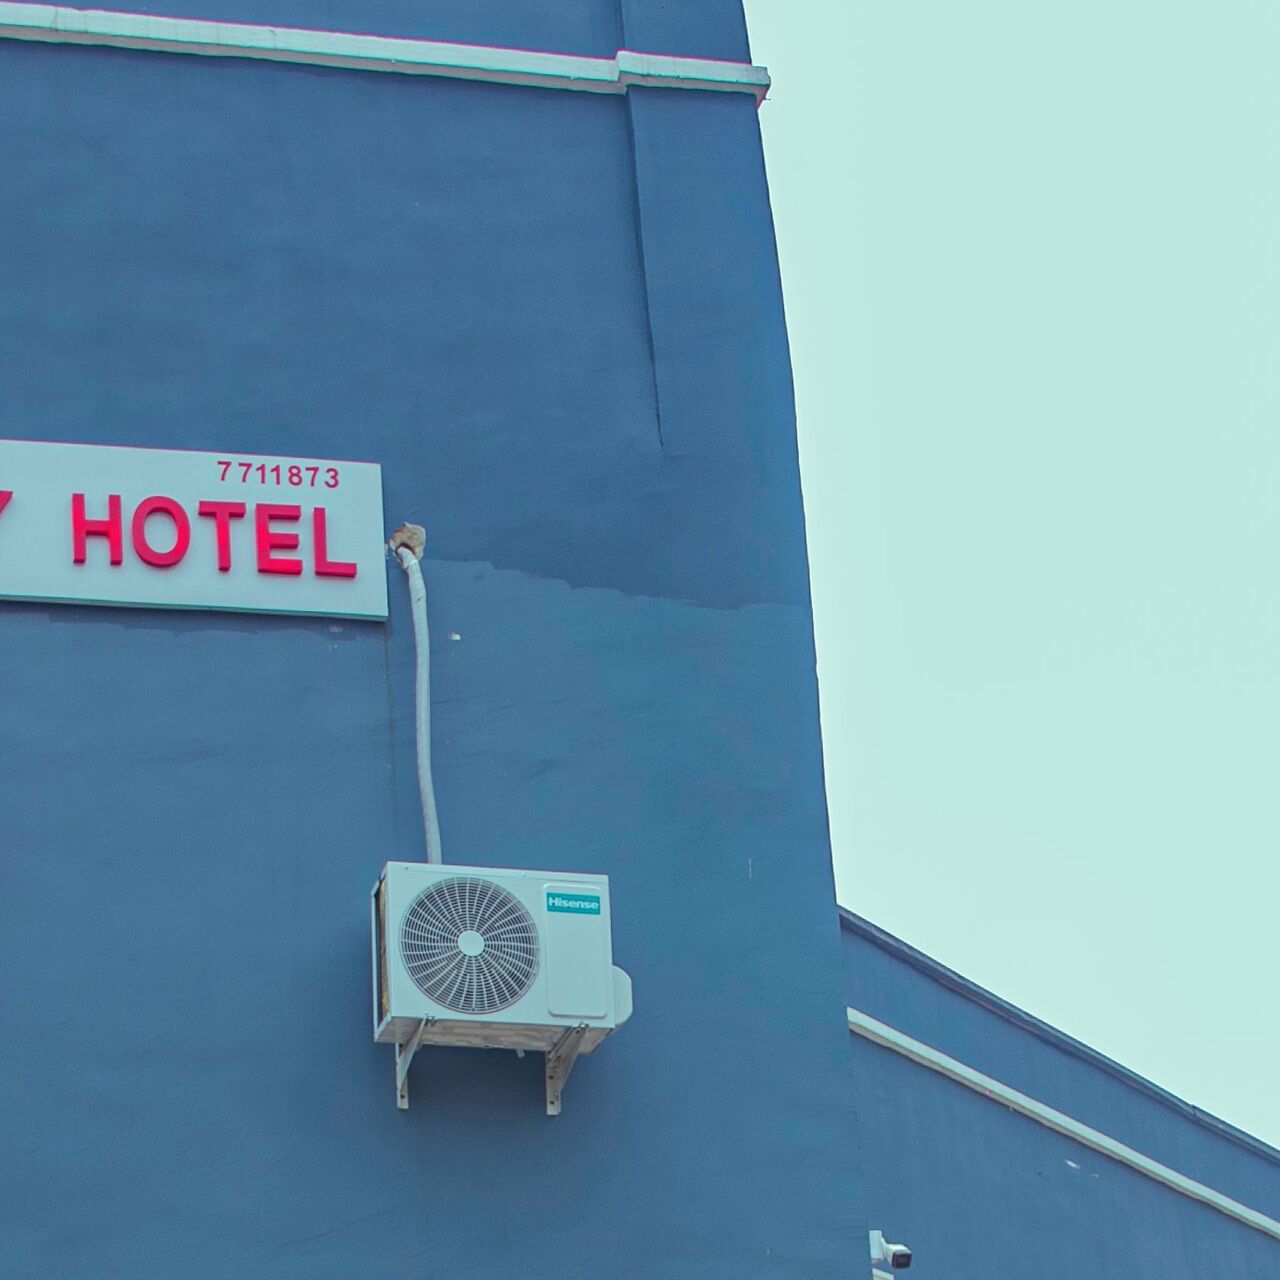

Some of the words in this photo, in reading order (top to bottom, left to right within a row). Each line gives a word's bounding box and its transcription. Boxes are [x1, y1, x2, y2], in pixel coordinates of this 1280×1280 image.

[217, 461, 339, 488] 7711873
[71, 493, 357, 578] HOTEL
[548, 897, 599, 909] Hisense
